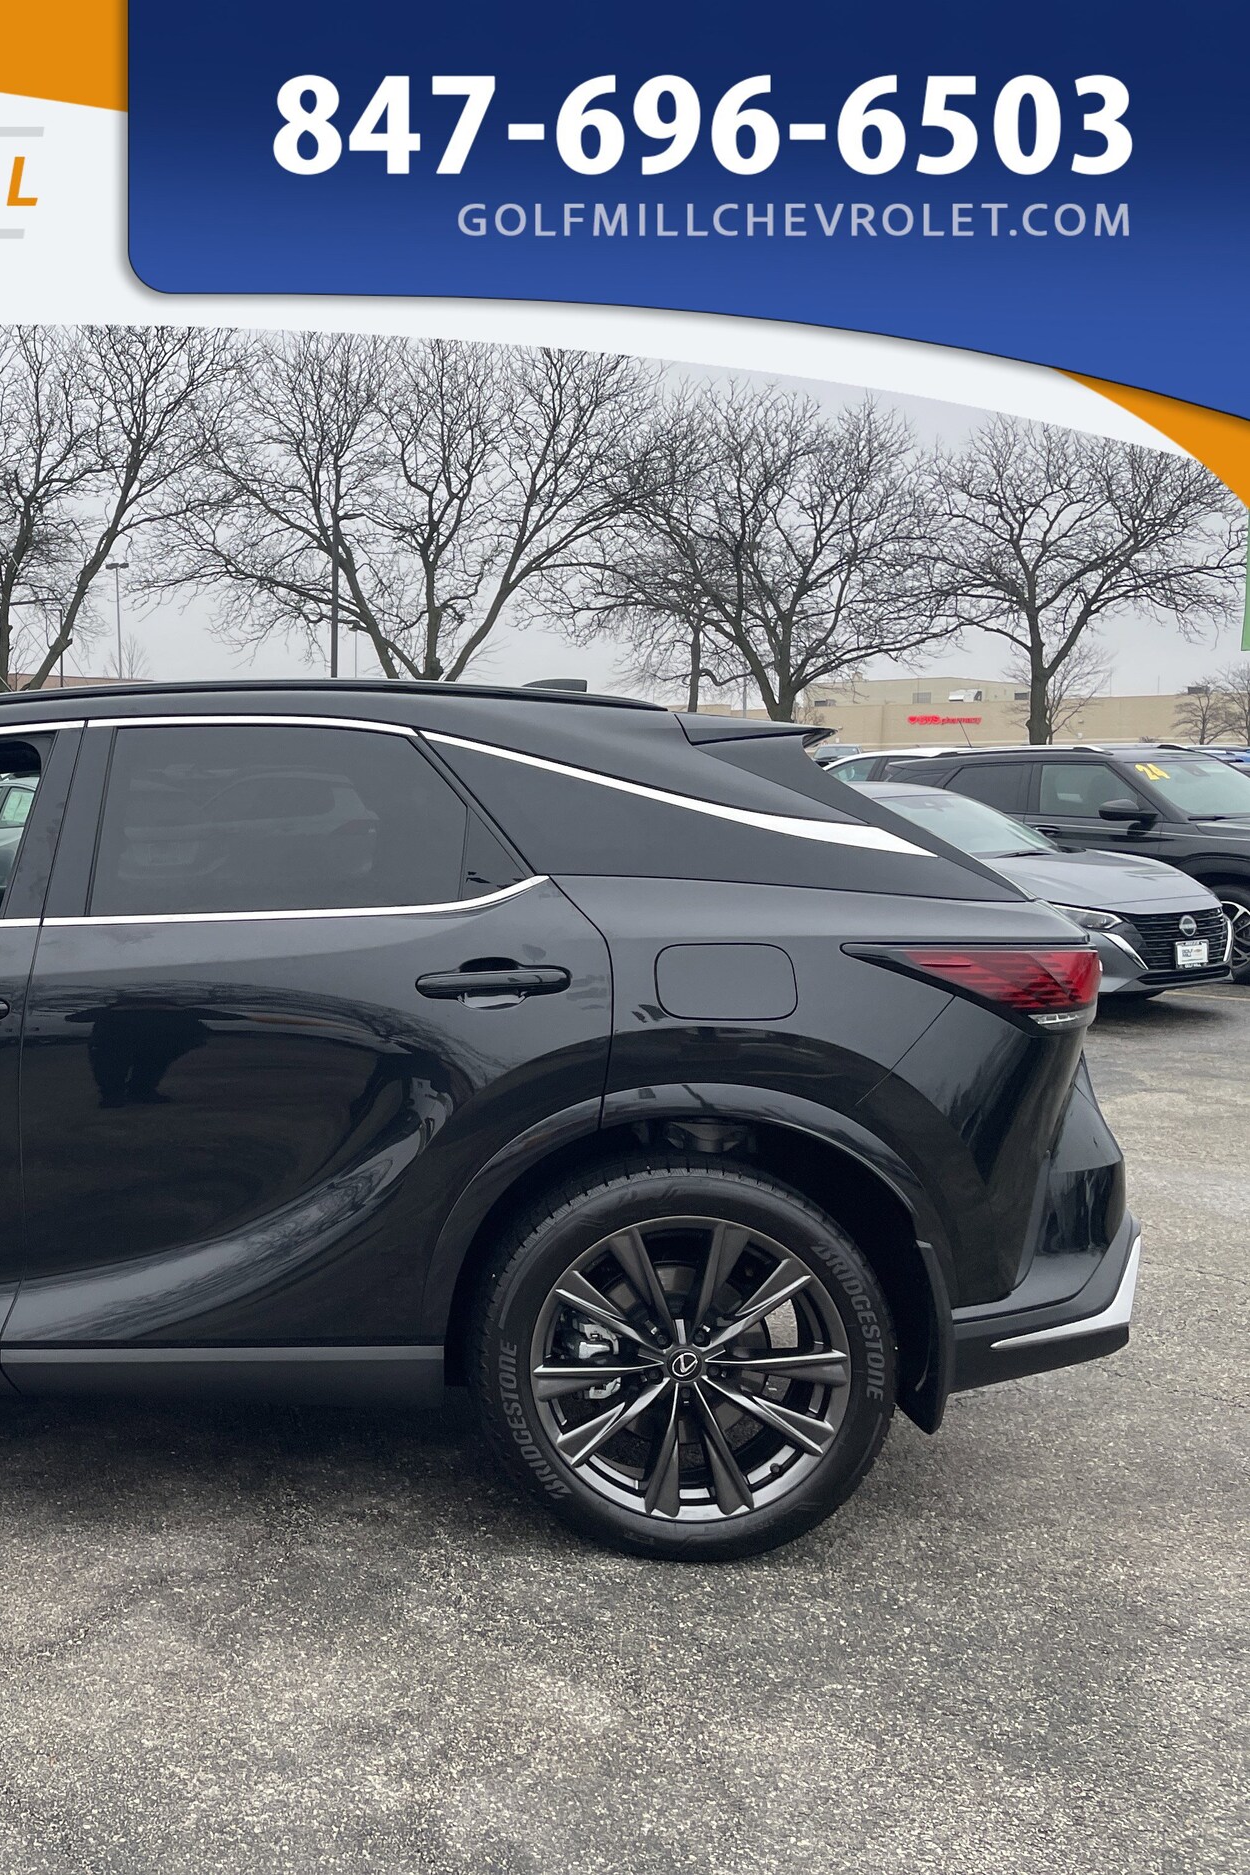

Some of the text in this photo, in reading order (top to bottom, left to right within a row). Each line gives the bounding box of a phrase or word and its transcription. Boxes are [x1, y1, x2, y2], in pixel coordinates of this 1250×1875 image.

[1134, 763, 1171, 781] 24
[810, 1241, 886, 1402] BRIDGESTONE
[498, 1340, 573, 1500] BRIDGESTONE
